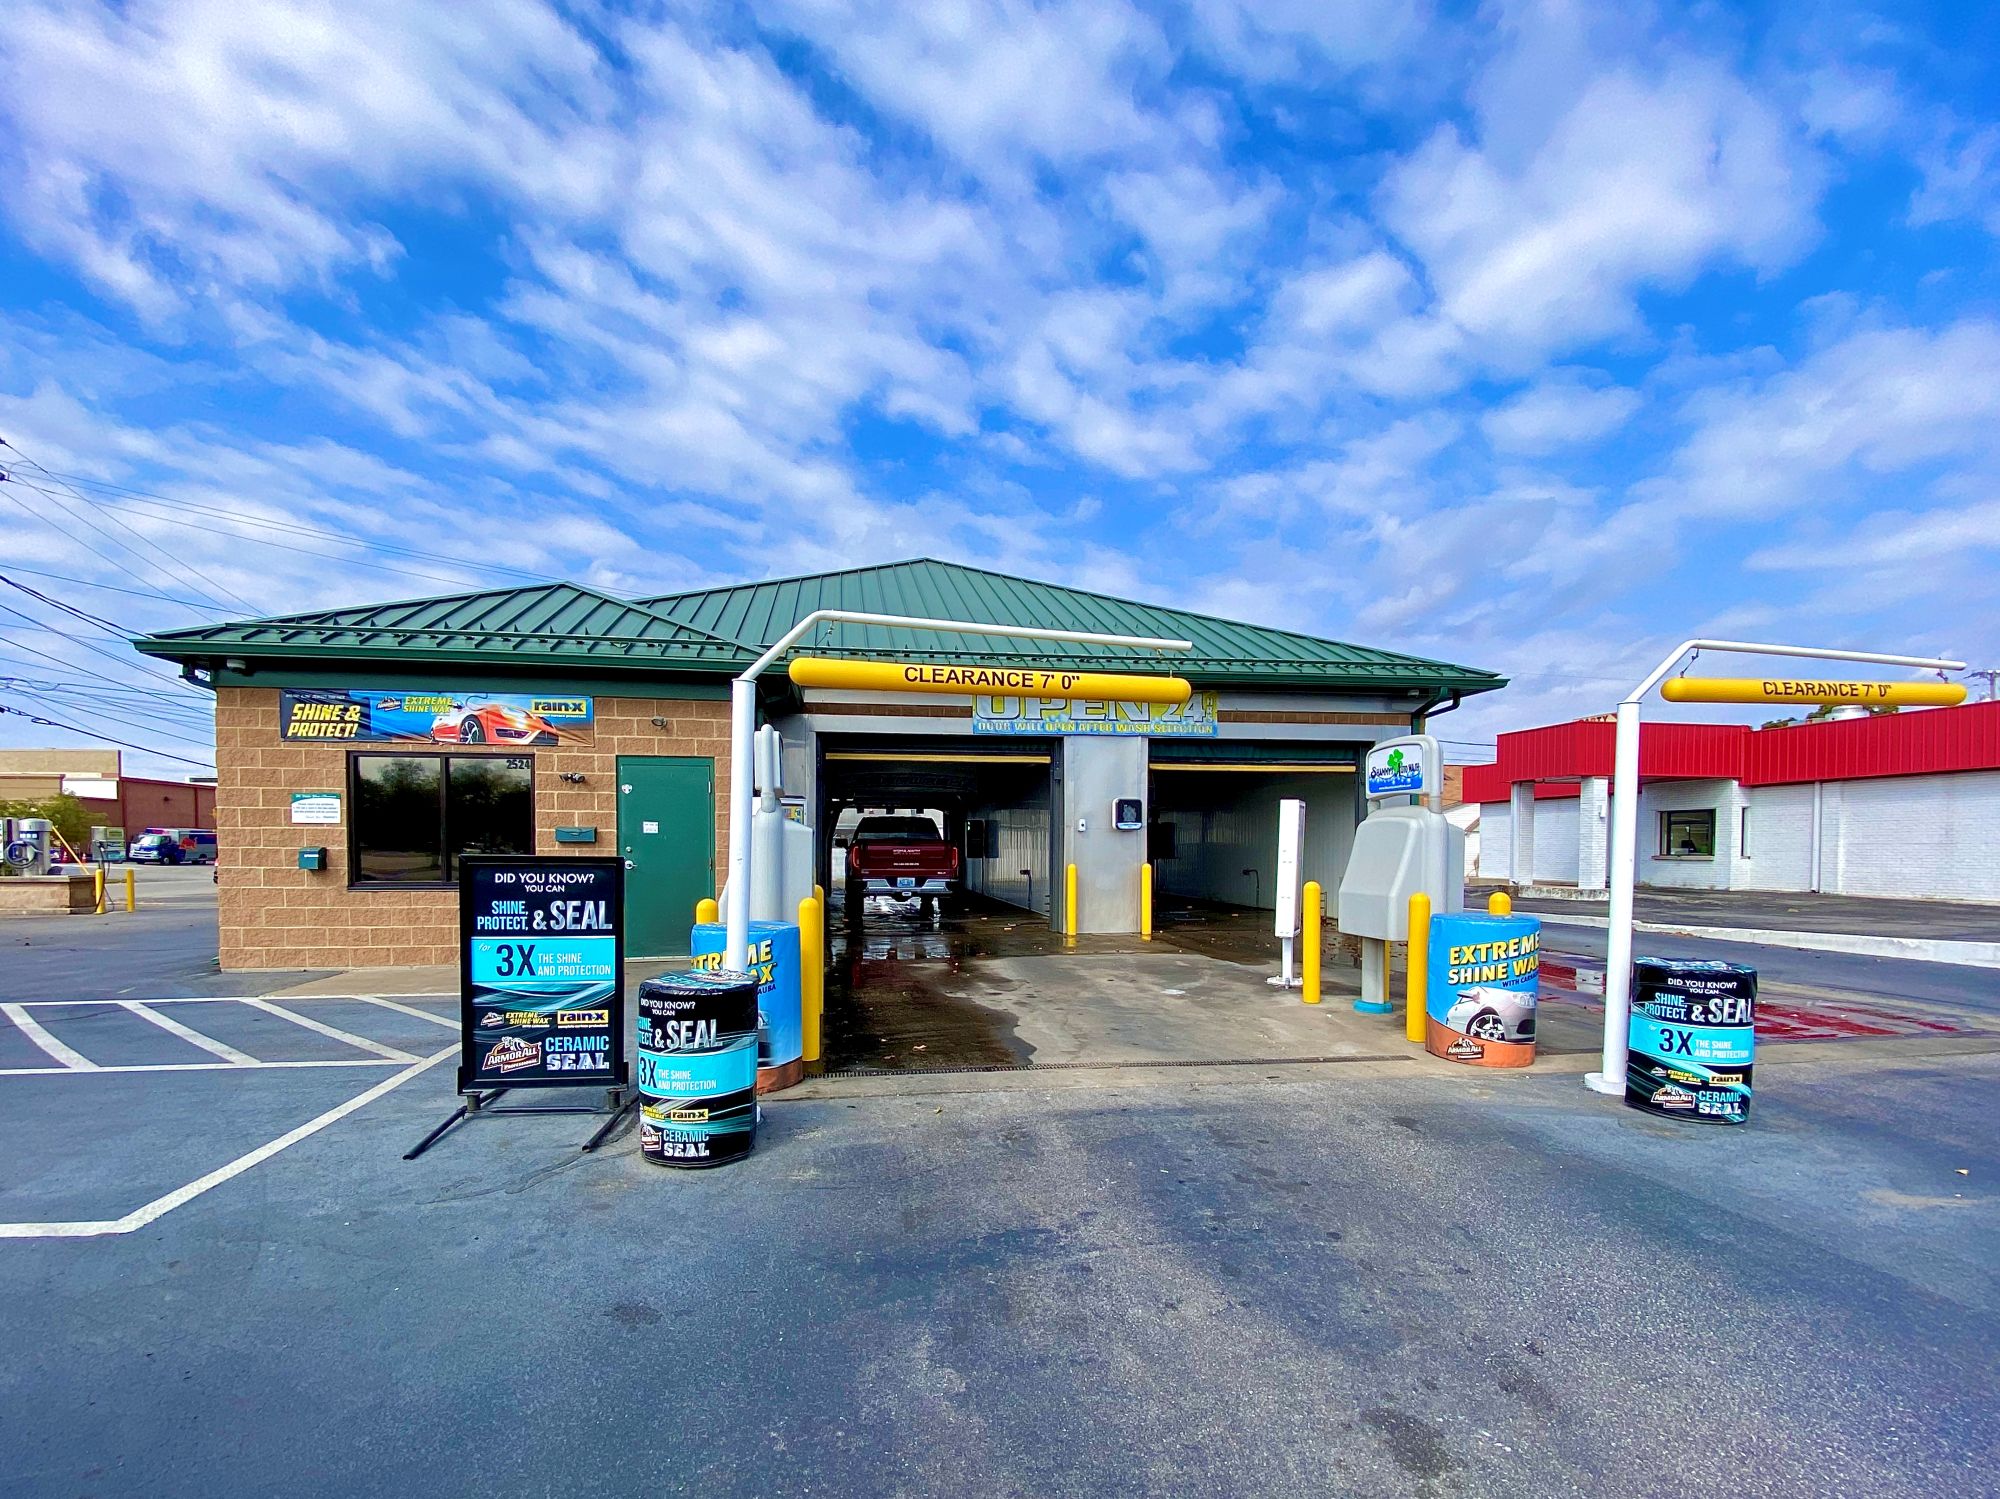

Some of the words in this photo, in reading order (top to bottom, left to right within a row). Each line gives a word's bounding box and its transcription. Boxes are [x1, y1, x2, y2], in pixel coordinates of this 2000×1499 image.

[904, 666, 1034, 688] CLEARANCE
[1040, 673, 1055, 689] 7'
[1061, 675, 1080, 690] 0"
[1762, 681, 1859, 697] CLEARANCE
[405, 696, 453, 705] EXTREME
[975, 693, 1151, 721] OPEN
[1161, 691, 1206, 722] 24
[291, 703, 345, 721] SHINE
[344, 705, 361, 722] &
[402, 704, 430, 713] SHINE
[286, 722, 359, 738] PROTECT!
[978, 722, 1011, 732] DOOR
[1014, 722, 1044, 732] WILL
[1045, 722, 1076, 733] OPEN
[1078, 723, 1113, 733] AFTER
[1116, 723, 1152, 733] WASH
[1154, 723, 1213, 734] SELECTION
[506, 760, 531, 770] 2524
[494, 873, 516, 884] DID
[518, 873, 546, 884] YOU
[548, 873, 595, 884] KNOW?
[525, 885, 544, 893] YOU
[545, 885, 565, 893] CAN
[491, 900, 529, 915] SHINE,
[532, 909, 548, 931] &
[549, 900, 613, 931] SEAL
[476, 916, 529, 931] PROTECT,
[478, 943, 491, 952] for
[1448, 930, 1540, 966] EXTREME
[495, 944, 537, 977] 3X
[538, 953, 556, 964] THE
[556, 953, 583, 964] SHINE
[537, 965, 556, 976] AND
[557, 964, 612, 976] PROTECTION
[1447, 961, 1509, 986] SHINE
[1667, 978, 1683, 986] DID
[1684, 979, 1705, 988] YOU
[1706, 981, 1738, 989] KNOW?
[640, 998, 649, 1006] DID
[649, 1000, 663, 1009] YOU
[664, 1001, 696, 1010] KNOW?
[505, 1011, 539, 1019] EXTREME
[1691, 1005, 1705, 1022] &
[509, 1017, 531, 1025] SHINE
[655, 1028, 665, 1048] &
[666, 1019, 723, 1049] SEAL
[545, 1036, 610, 1052] CERAMIC
[1658, 1028, 1693, 1057] 3X
[1695, 1039, 1711, 1049] THE
[1711, 1040, 1733, 1050] SHINE
[1694, 1049, 1711, 1058] AND
[546, 1053, 610, 1070] SEAL
[639, 1057, 657, 1089] 3X
[658, 1069, 670, 1080] THE
[670, 1069, 692, 1080] SHINE
[657, 1080, 671, 1090] AND
[671, 1079, 717, 1091] PROTECTION
[1698, 1090, 1742, 1103] CERAMIC
[1698, 1102, 1741, 1115] SEAL
[663, 1129, 710, 1143] CERAMIC
[663, 1142, 710, 1158] SEAL
